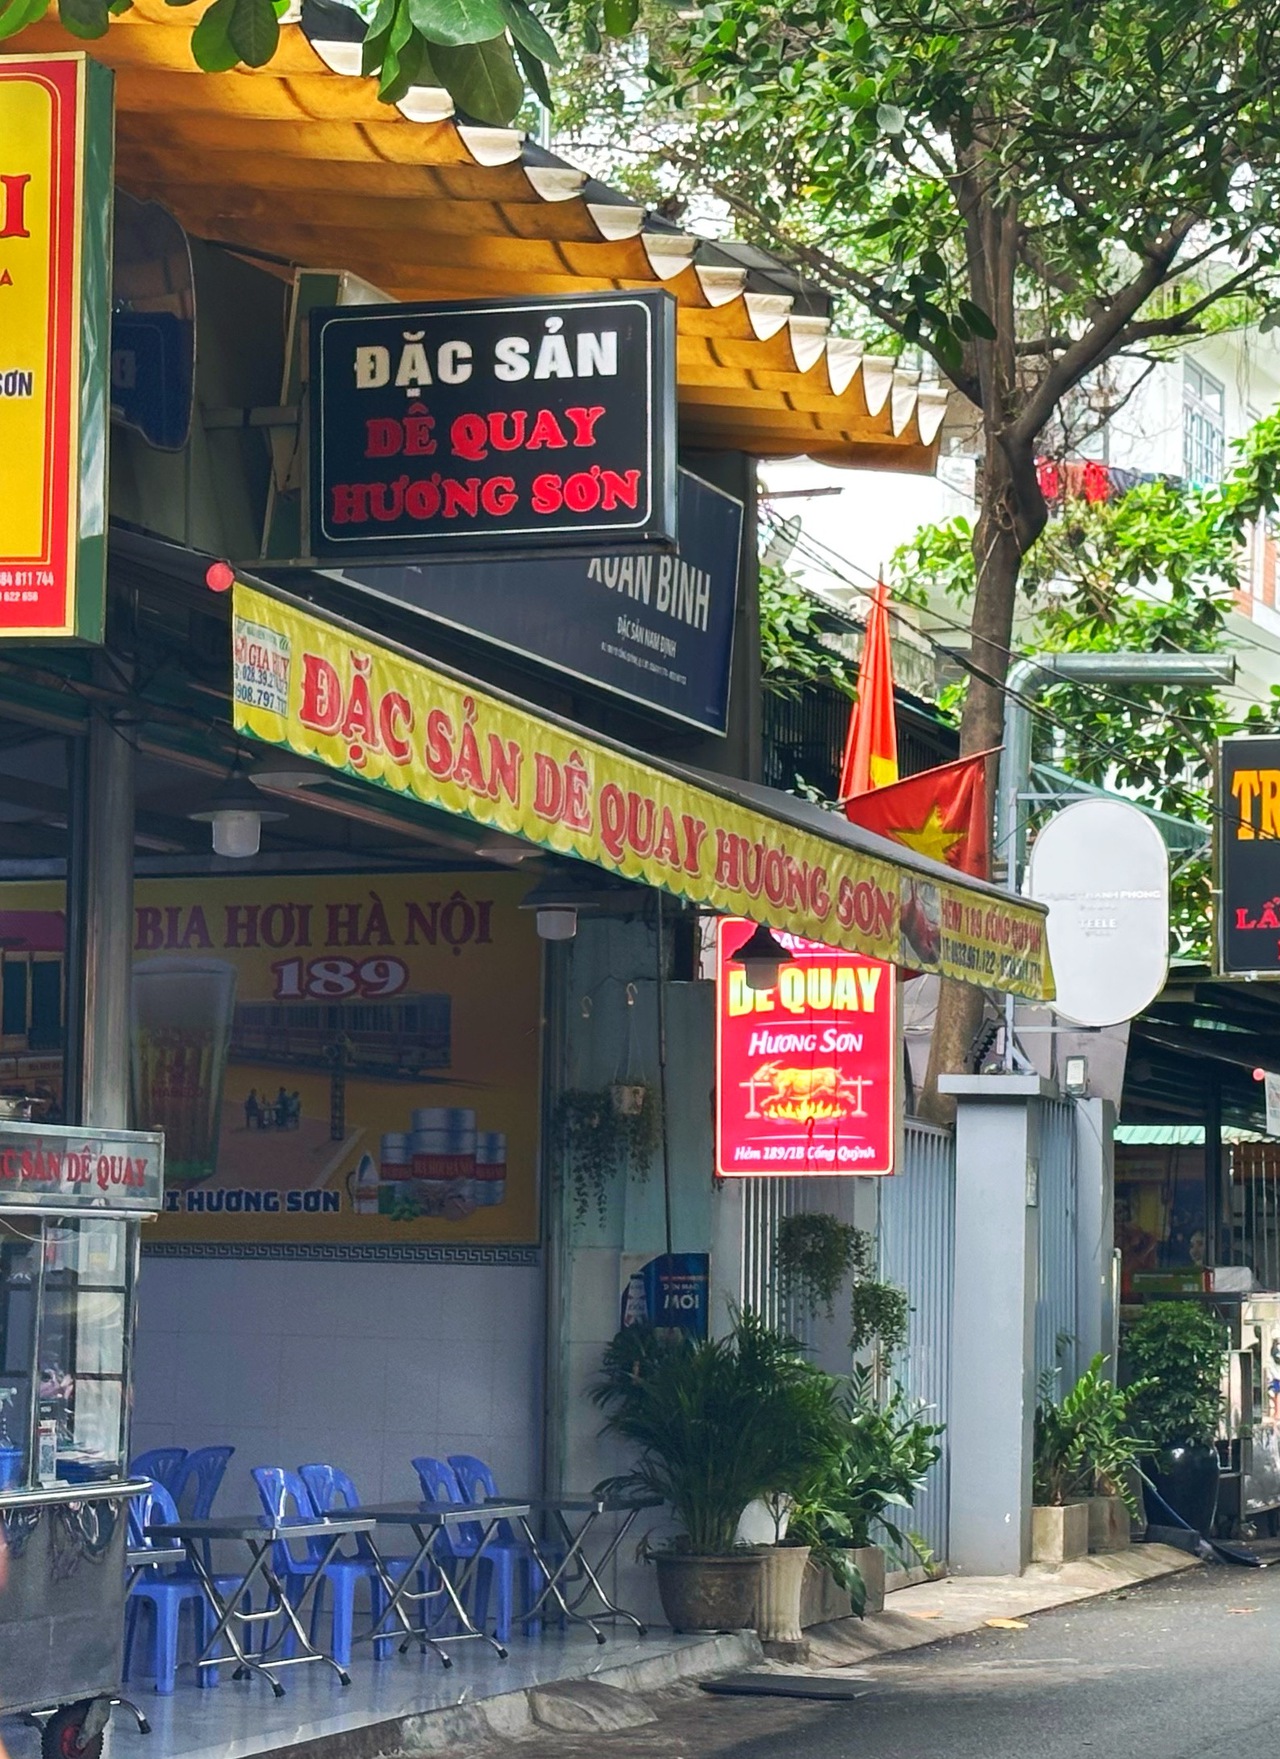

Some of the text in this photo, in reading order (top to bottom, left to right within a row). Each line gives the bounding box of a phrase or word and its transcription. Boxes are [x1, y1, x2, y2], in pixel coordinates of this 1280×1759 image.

[354, 316, 618, 398] ĐẶC SẢN
[364, 402, 606, 461] DÊ QUAY
[331, 465, 641, 524] HƯƠNG SƠN
[299, 650, 897, 942] ĐẶC SẢN DÊ QUAY HƯƠNG SƠN
[134, 890, 494, 956] BIA HƠI HÀ NỘI
[270, 955, 409, 1000] 189
[780, 967, 882, 1014] QUAY
[22, 1138, 61, 1181] SẢN
[67, 1145, 92, 1183] DÊ
[97, 1154, 148, 1191] QUAY
[187, 1188, 280, 1213] HƯƠNG
[286, 1188, 341, 1213] SƠN
